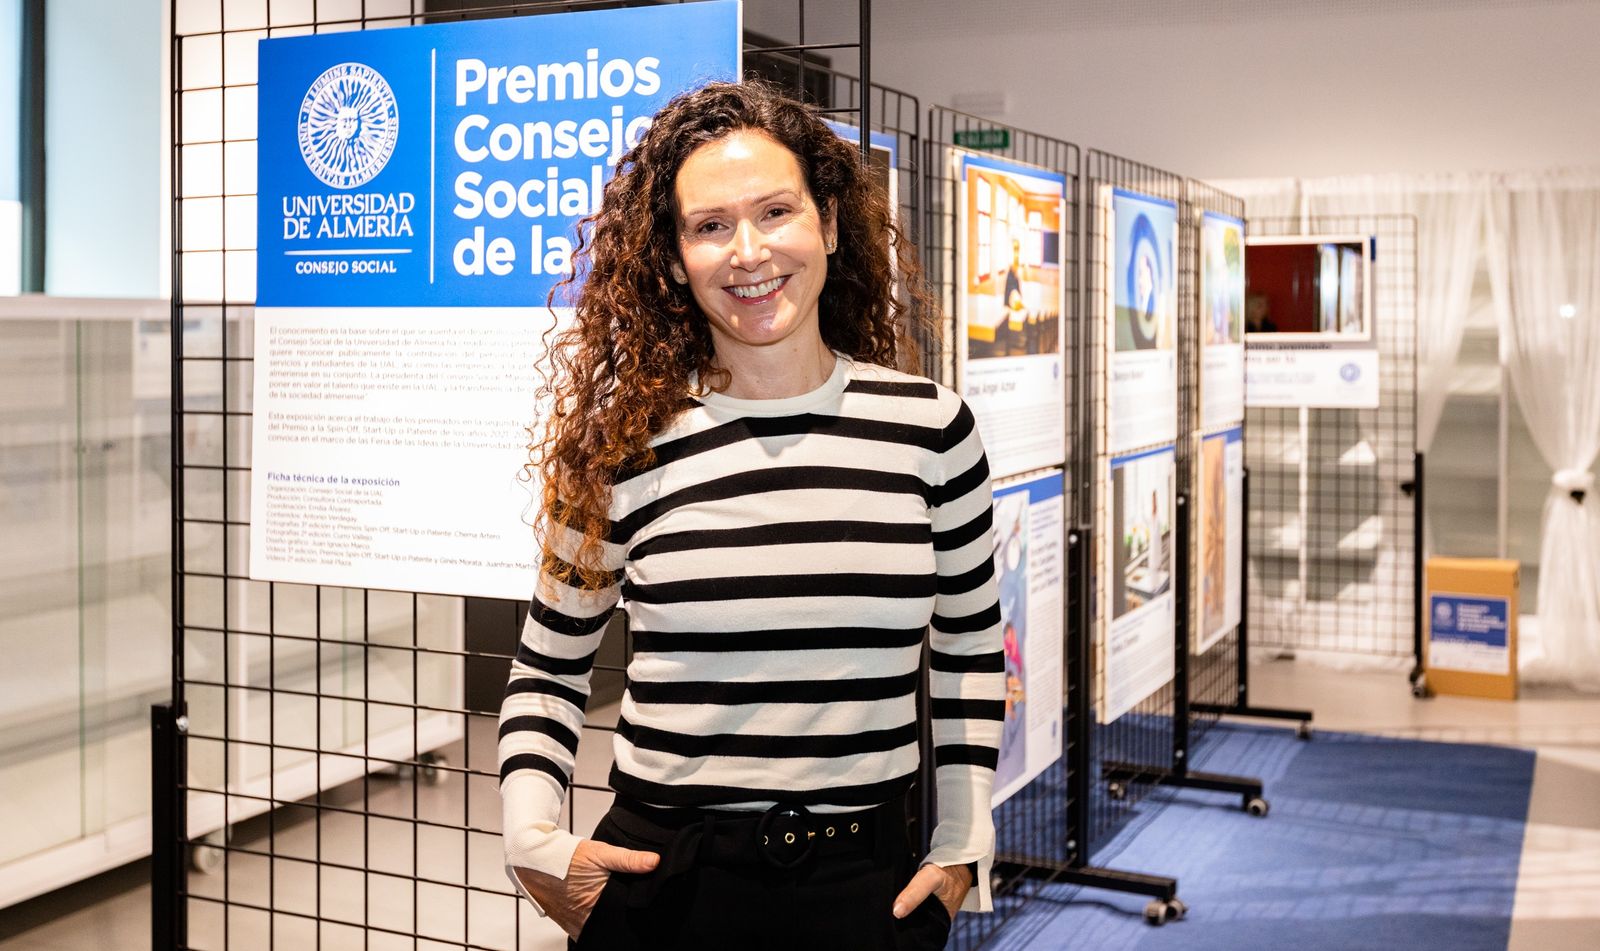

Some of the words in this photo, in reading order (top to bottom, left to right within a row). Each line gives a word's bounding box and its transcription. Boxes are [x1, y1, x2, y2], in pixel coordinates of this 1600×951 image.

[455, 48, 661, 107] Premios
[453, 164, 603, 220] Social
[282, 192, 415, 217] UNIVERSIDAD
[283, 217, 311, 240] DE
[316, 212, 414, 239] ALMERÍA
[453, 226, 516, 276] de
[531, 225, 573, 275] la
[295, 260, 349, 276] CONSEJO
[351, 260, 397, 274] SOCIAL
[278, 327, 328, 335] conocimiento
[348, 327, 367, 335] base
[368, 327, 391, 336] sobre
[278, 337, 308, 347] Consejo
[269, 349, 293, 358] quiere
[269, 369, 308, 377] almeriense
[269, 382, 290, 390] poner
[303, 380, 321, 388] valor
[332, 381, 359, 389] talento
[289, 391, 322, 399] sociedad
[268, 412, 284, 420] Esta
[286, 413, 326, 424] exposición
[363, 415, 391, 426] trabajo
[282, 423, 308, 431] Premio
[267, 472, 290, 482] Ficha
[293, 474, 325, 483] técnica
[327, 475, 338, 484] de
[340, 476, 349, 484] la
[351, 477, 400, 489] exposición
